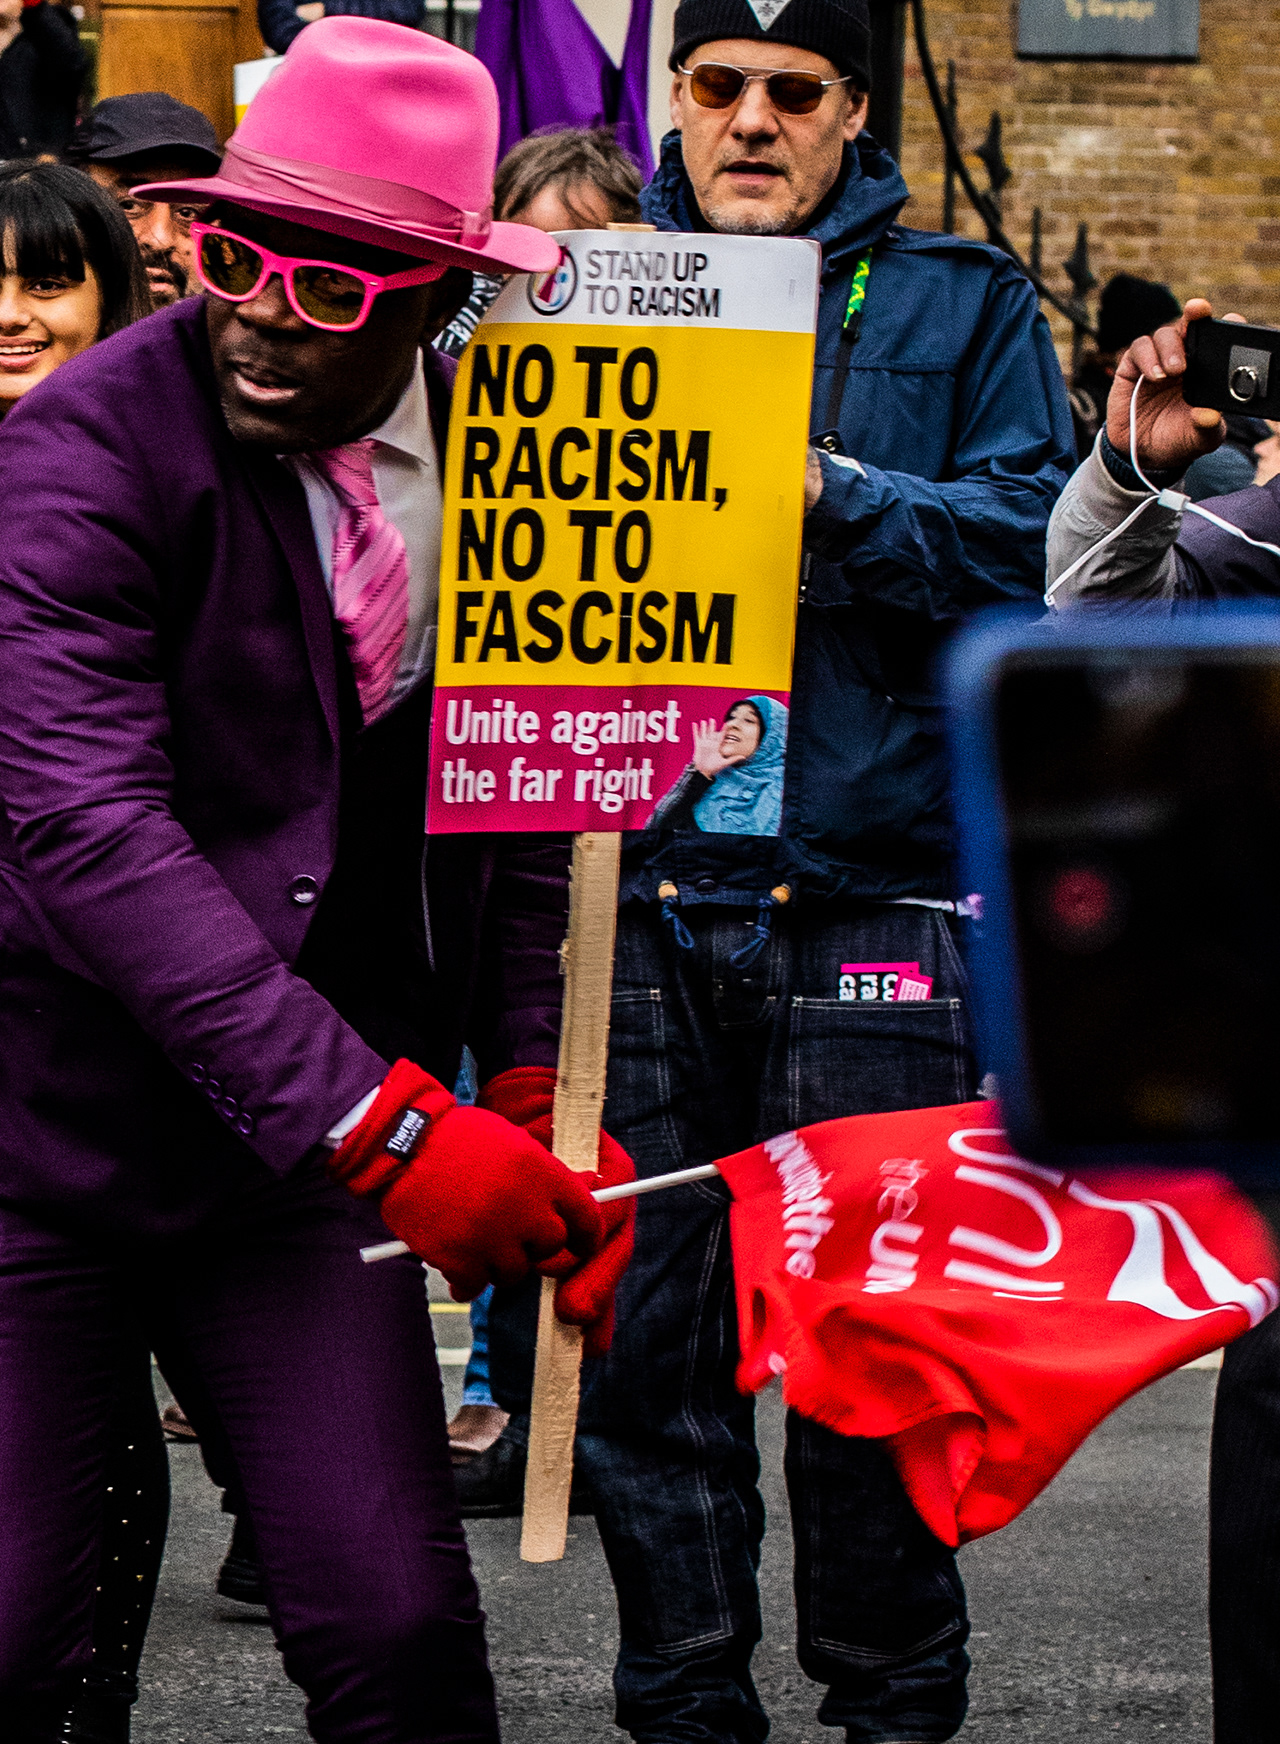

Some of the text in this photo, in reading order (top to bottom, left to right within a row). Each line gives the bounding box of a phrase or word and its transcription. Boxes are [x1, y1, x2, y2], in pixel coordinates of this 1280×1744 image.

[586, 248, 709, 283] STAND UP
[586, 282, 721, 319] TO RACISM
[467, 344, 659, 421] NO TO
[461, 425, 729, 512] RACISM,
[456, 507, 652, 584] NO TO
[452, 589, 738, 667] FASCISM
[445, 698, 682, 757] Unite against
[441, 757, 655, 815] the far right
[387, 1109, 420, 1151] Thermal
